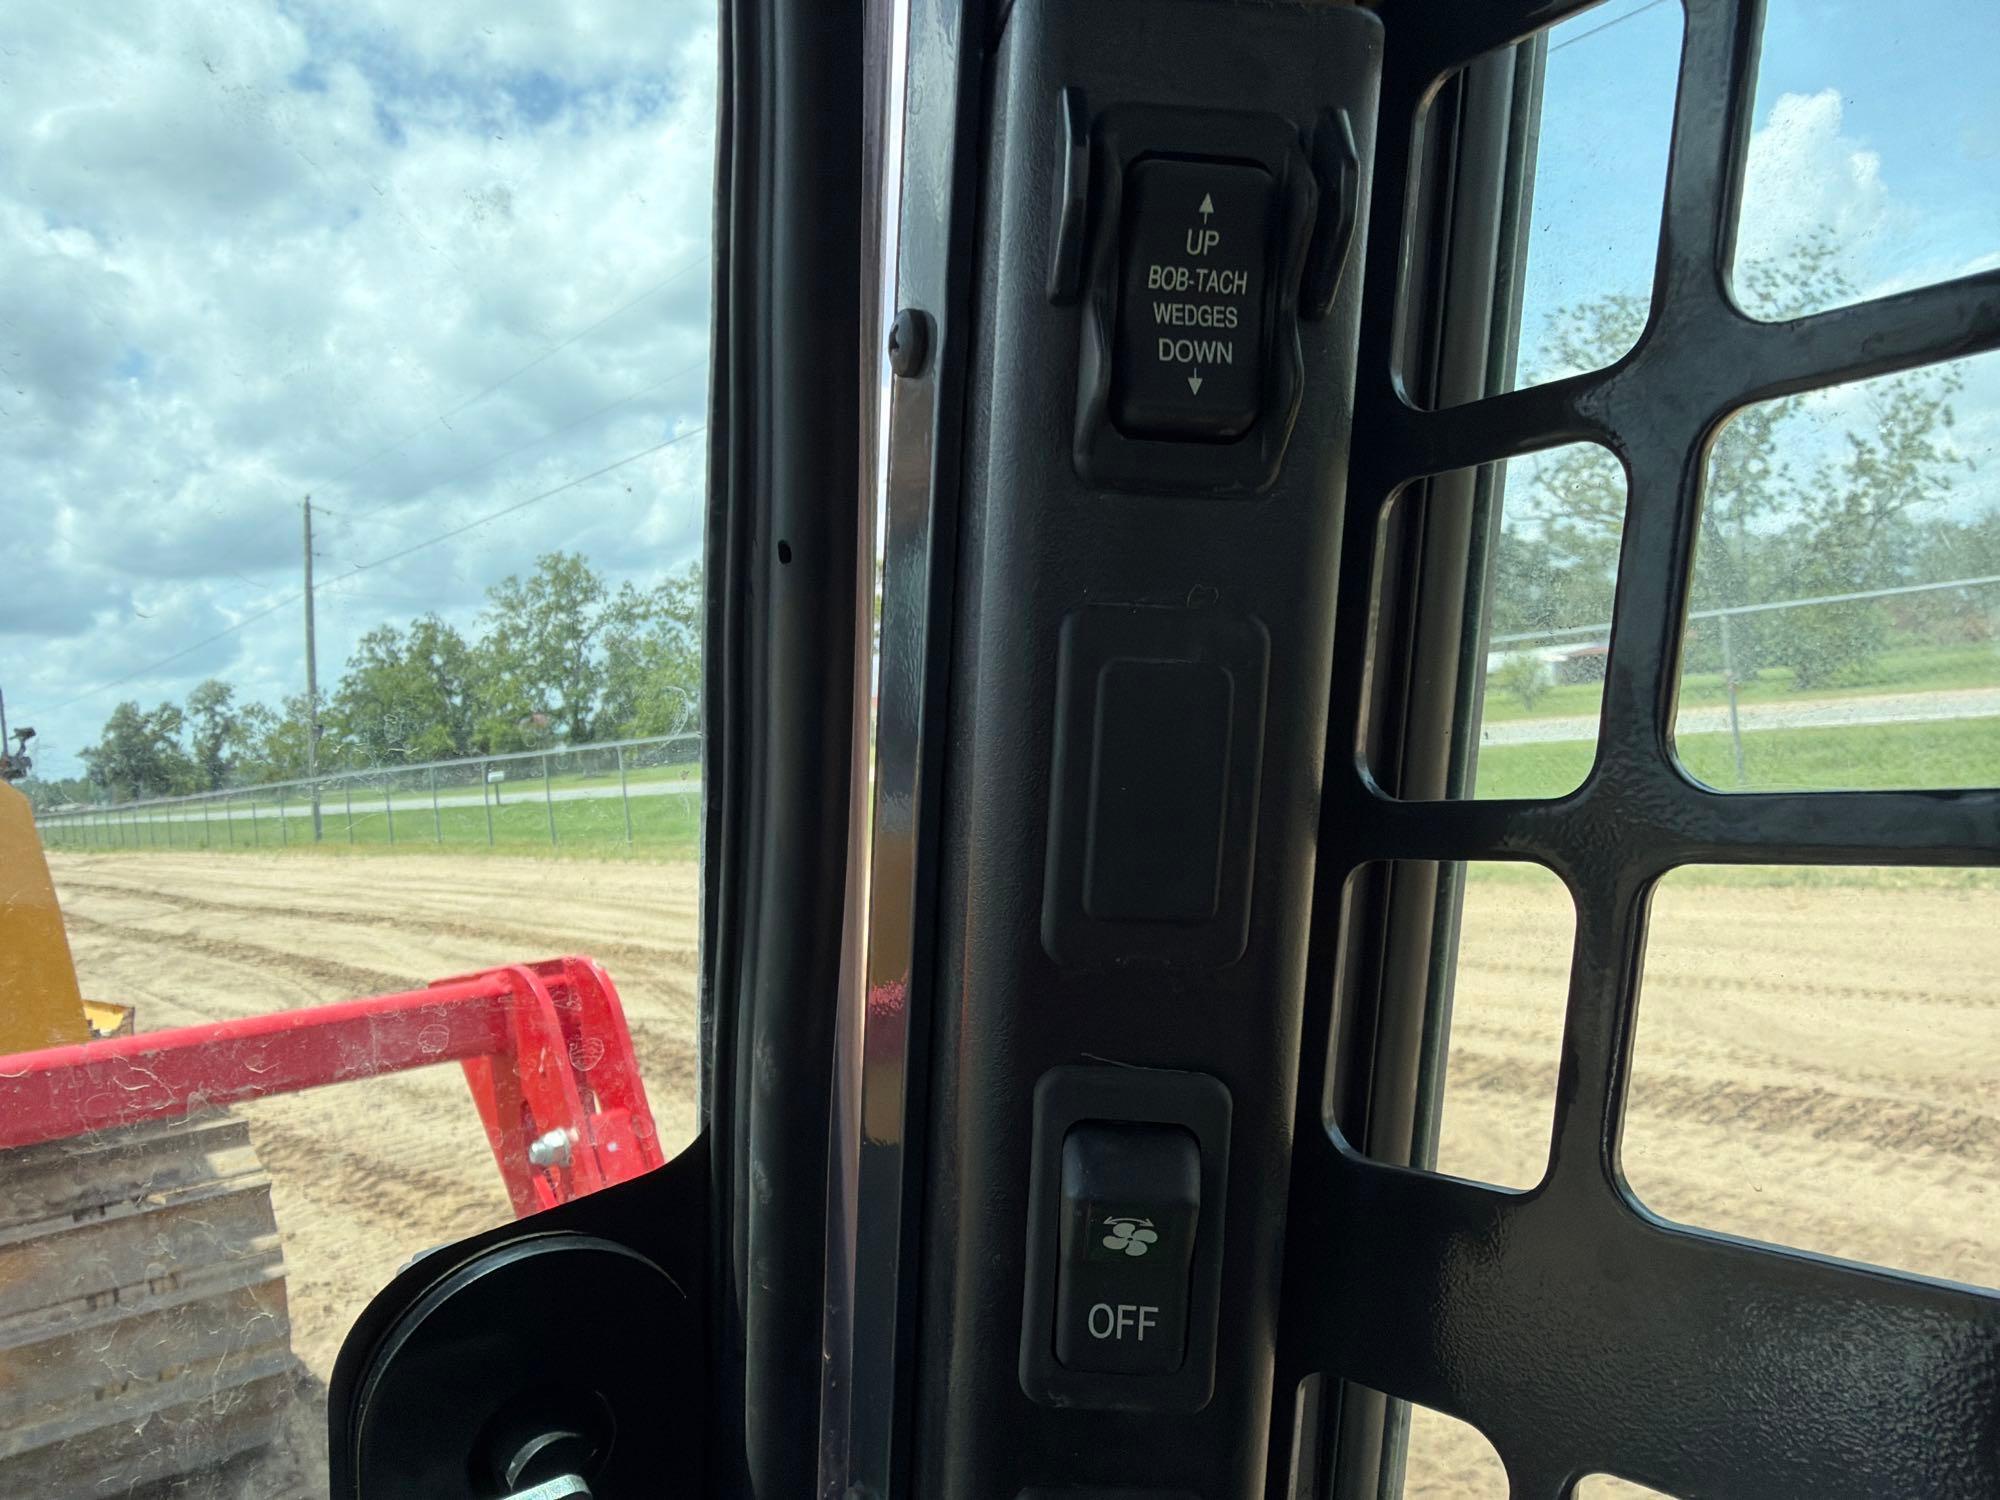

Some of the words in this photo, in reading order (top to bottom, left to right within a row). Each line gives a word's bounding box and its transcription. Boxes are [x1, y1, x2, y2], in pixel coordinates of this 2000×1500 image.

[1186, 229, 1220, 256] UP
[1148, 265, 1248, 294] BOB-TACH
[1153, 302, 1238, 328] WEDGES
[1158, 338, 1233, 364] DOWN
[1088, 1303, 1160, 1341] OFF
